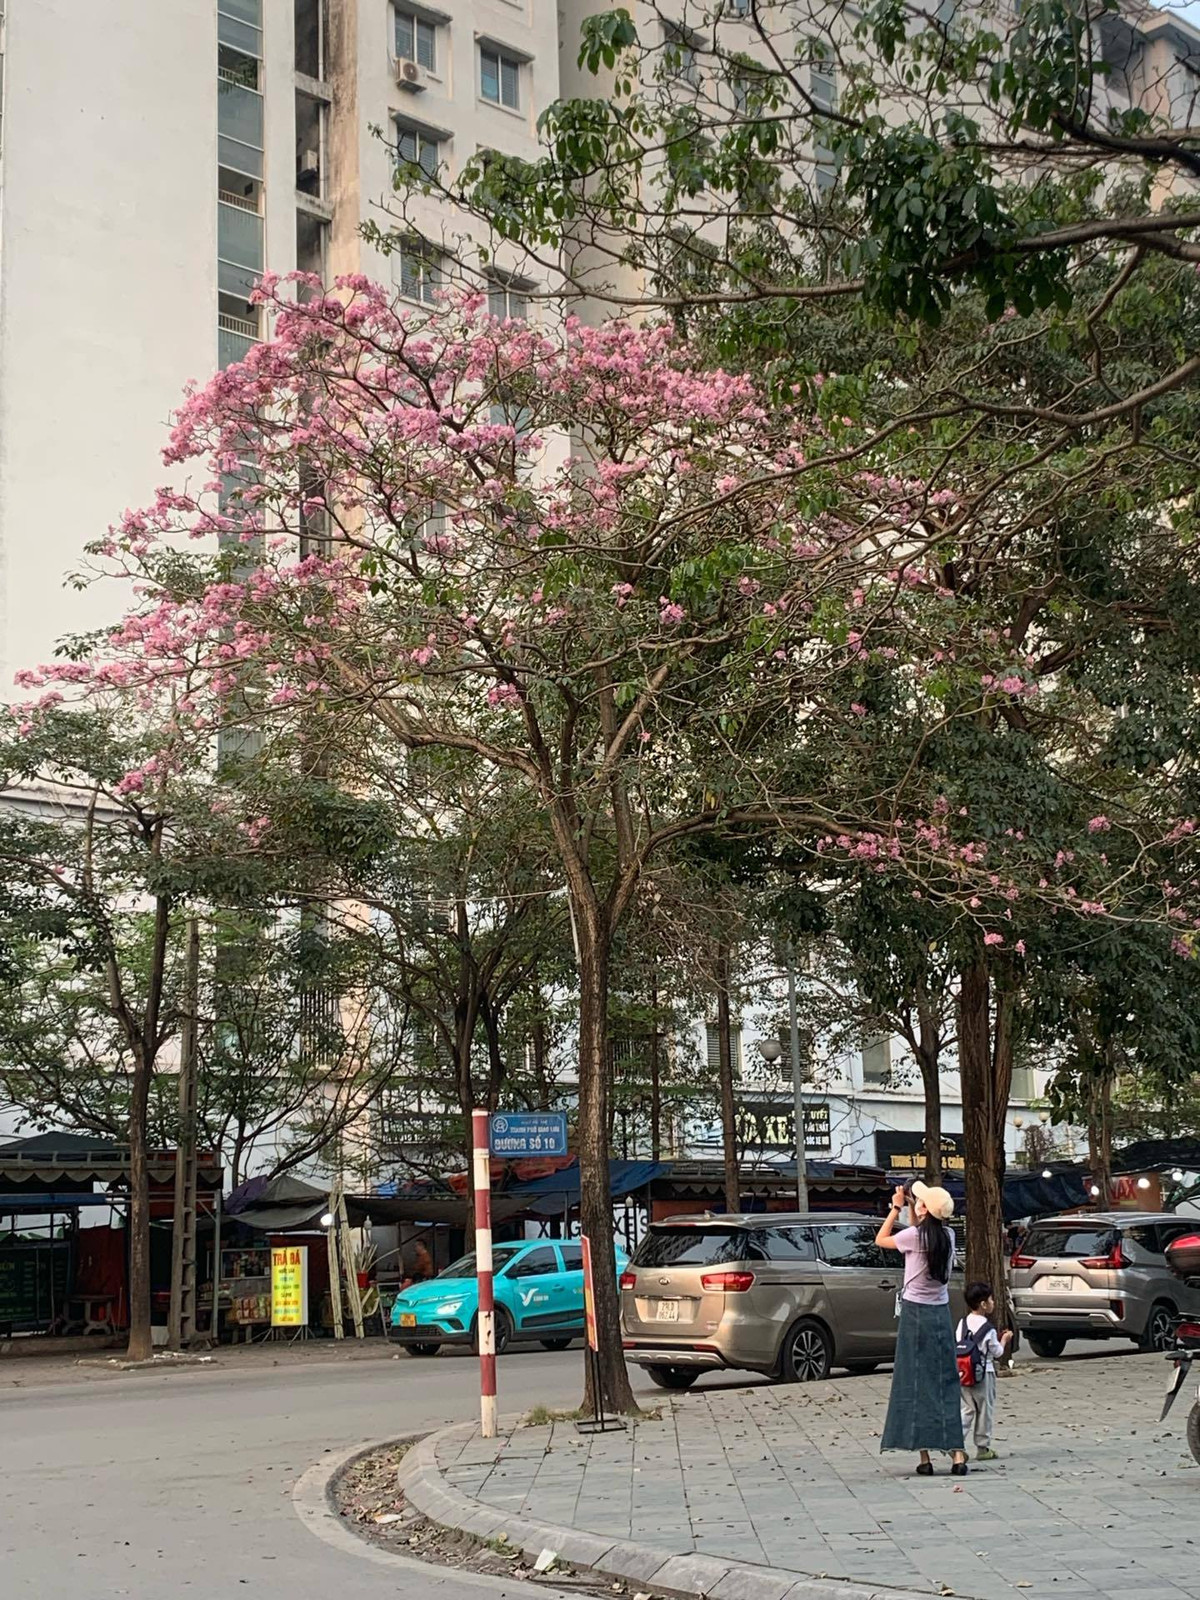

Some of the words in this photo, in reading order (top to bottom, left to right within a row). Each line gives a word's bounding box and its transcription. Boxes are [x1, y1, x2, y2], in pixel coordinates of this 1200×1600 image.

[808, 1107, 828, 1120] UYẾT
[762, 1115, 790, 1144] XE
[494, 1135, 527, 1151] ĐƯỜNG
[529, 1134, 542, 1150] SỐ
[544, 1137, 556, 1149] 10
